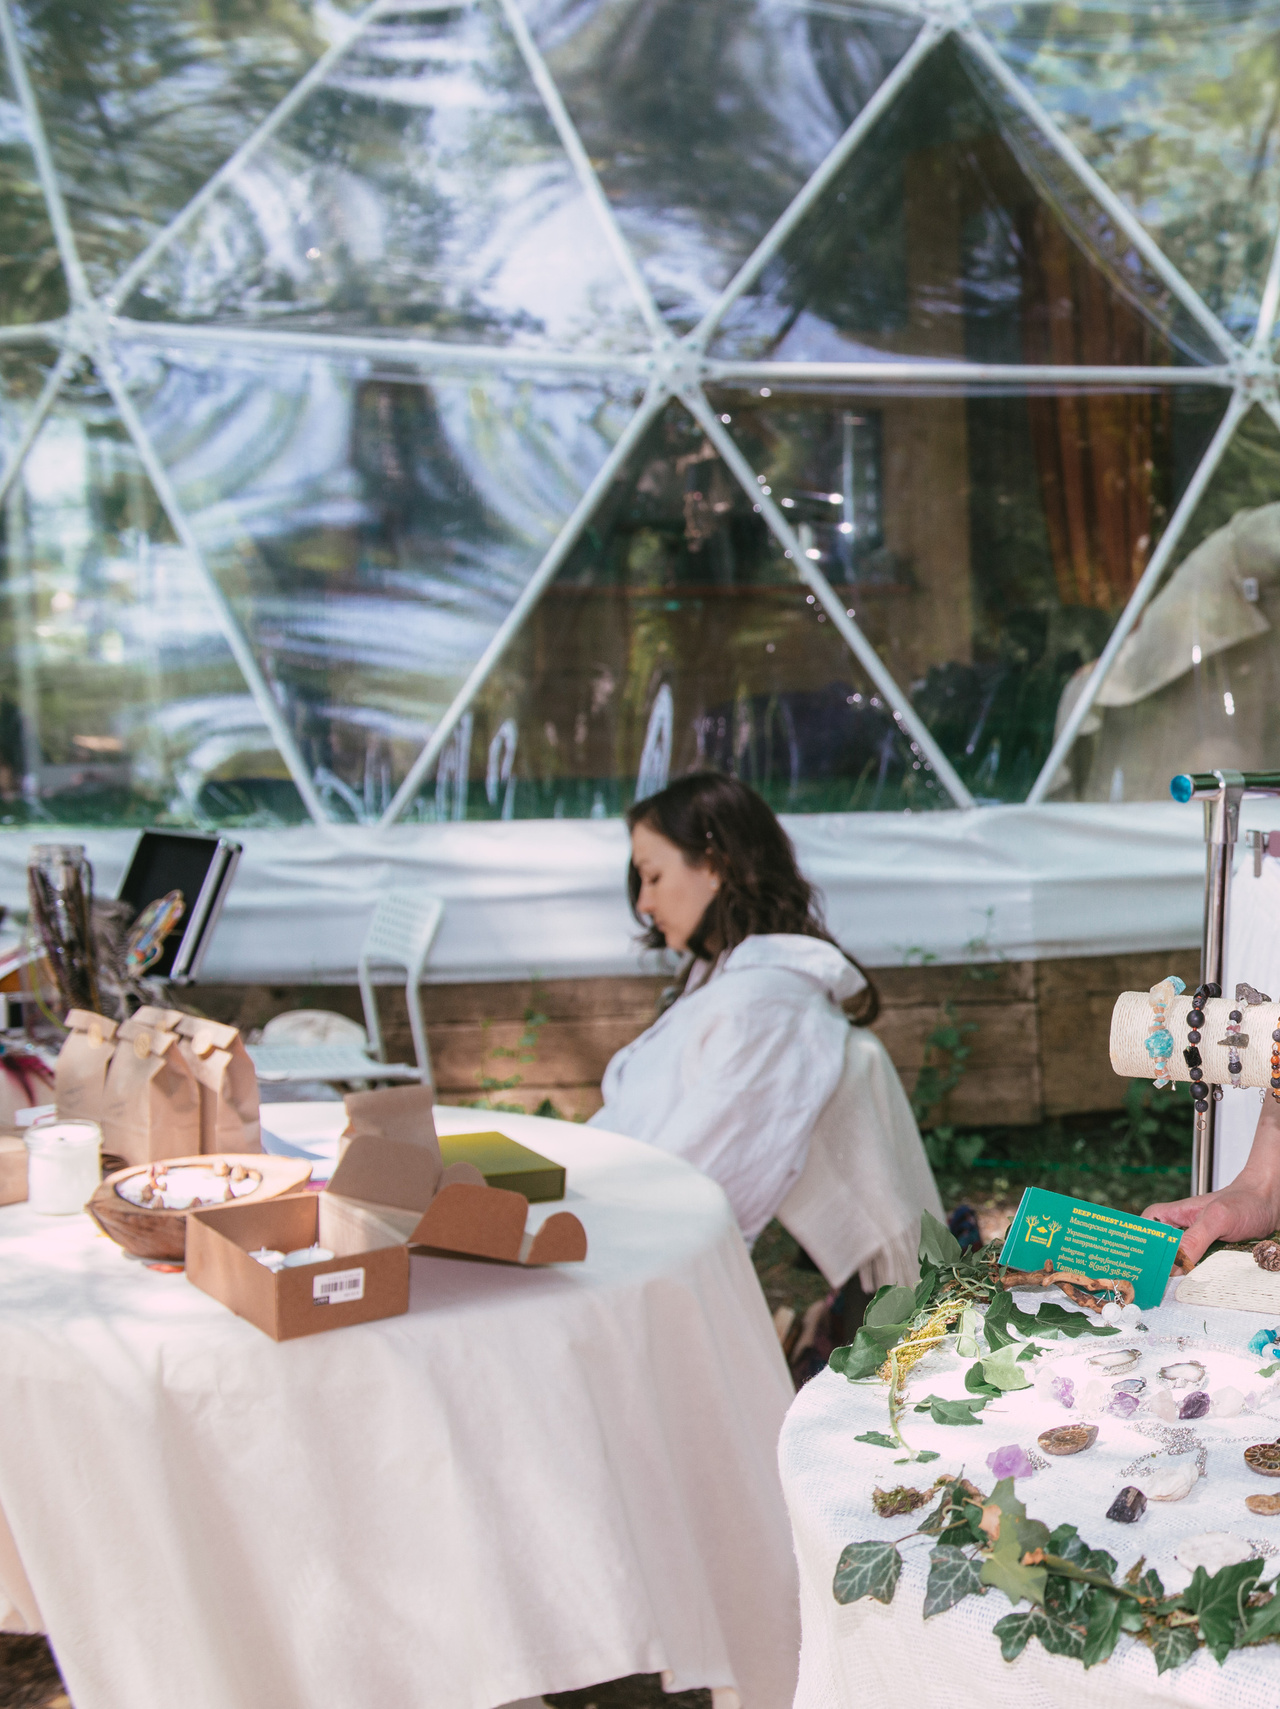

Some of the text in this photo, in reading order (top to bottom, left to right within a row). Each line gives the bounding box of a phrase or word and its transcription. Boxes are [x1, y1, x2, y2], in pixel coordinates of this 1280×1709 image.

[1069, 1216, 1107, 1232] Мастерская
[1072, 1208, 1167, 1239] DEEP FOREST LABORATORY
[1066, 1227, 1098, 1241] Украшения
[1101, 1239, 1130, 1251] предметы
[1072, 1238, 1109, 1252] натуральных
[1109, 1247, 1131, 1258] камней
